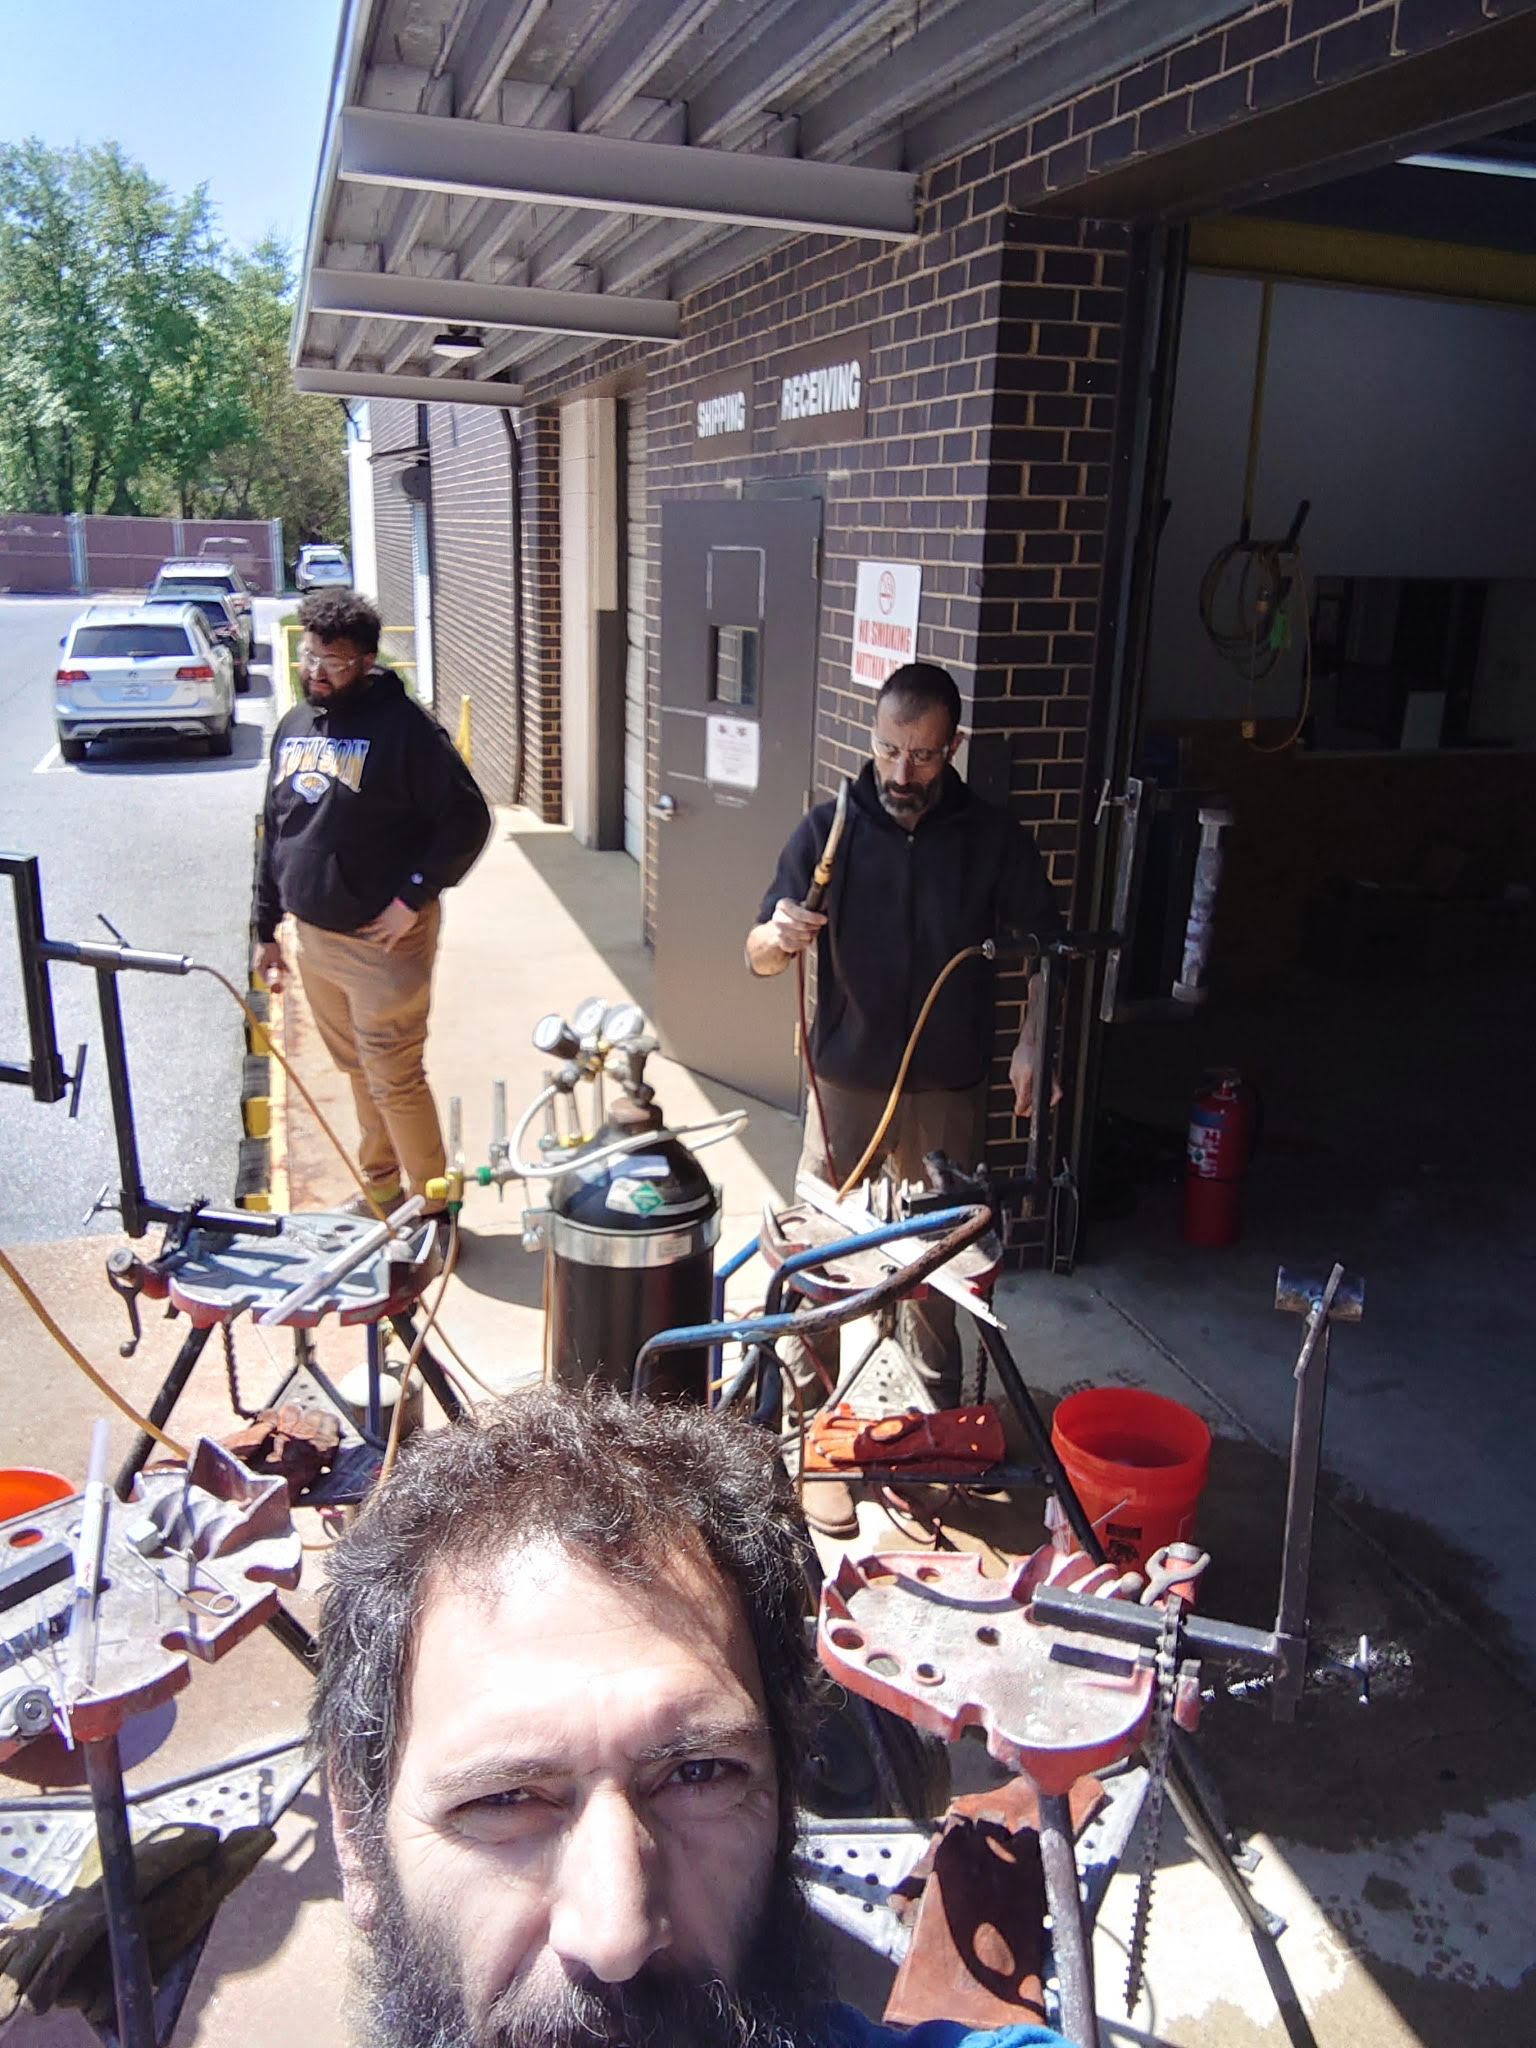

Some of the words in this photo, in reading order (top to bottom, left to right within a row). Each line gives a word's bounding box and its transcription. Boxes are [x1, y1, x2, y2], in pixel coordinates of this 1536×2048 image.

[697, 391, 745, 438] SHIPPING
[781, 361, 861, 421] RECEIVING
[273, 737, 370, 793] TOWSON
